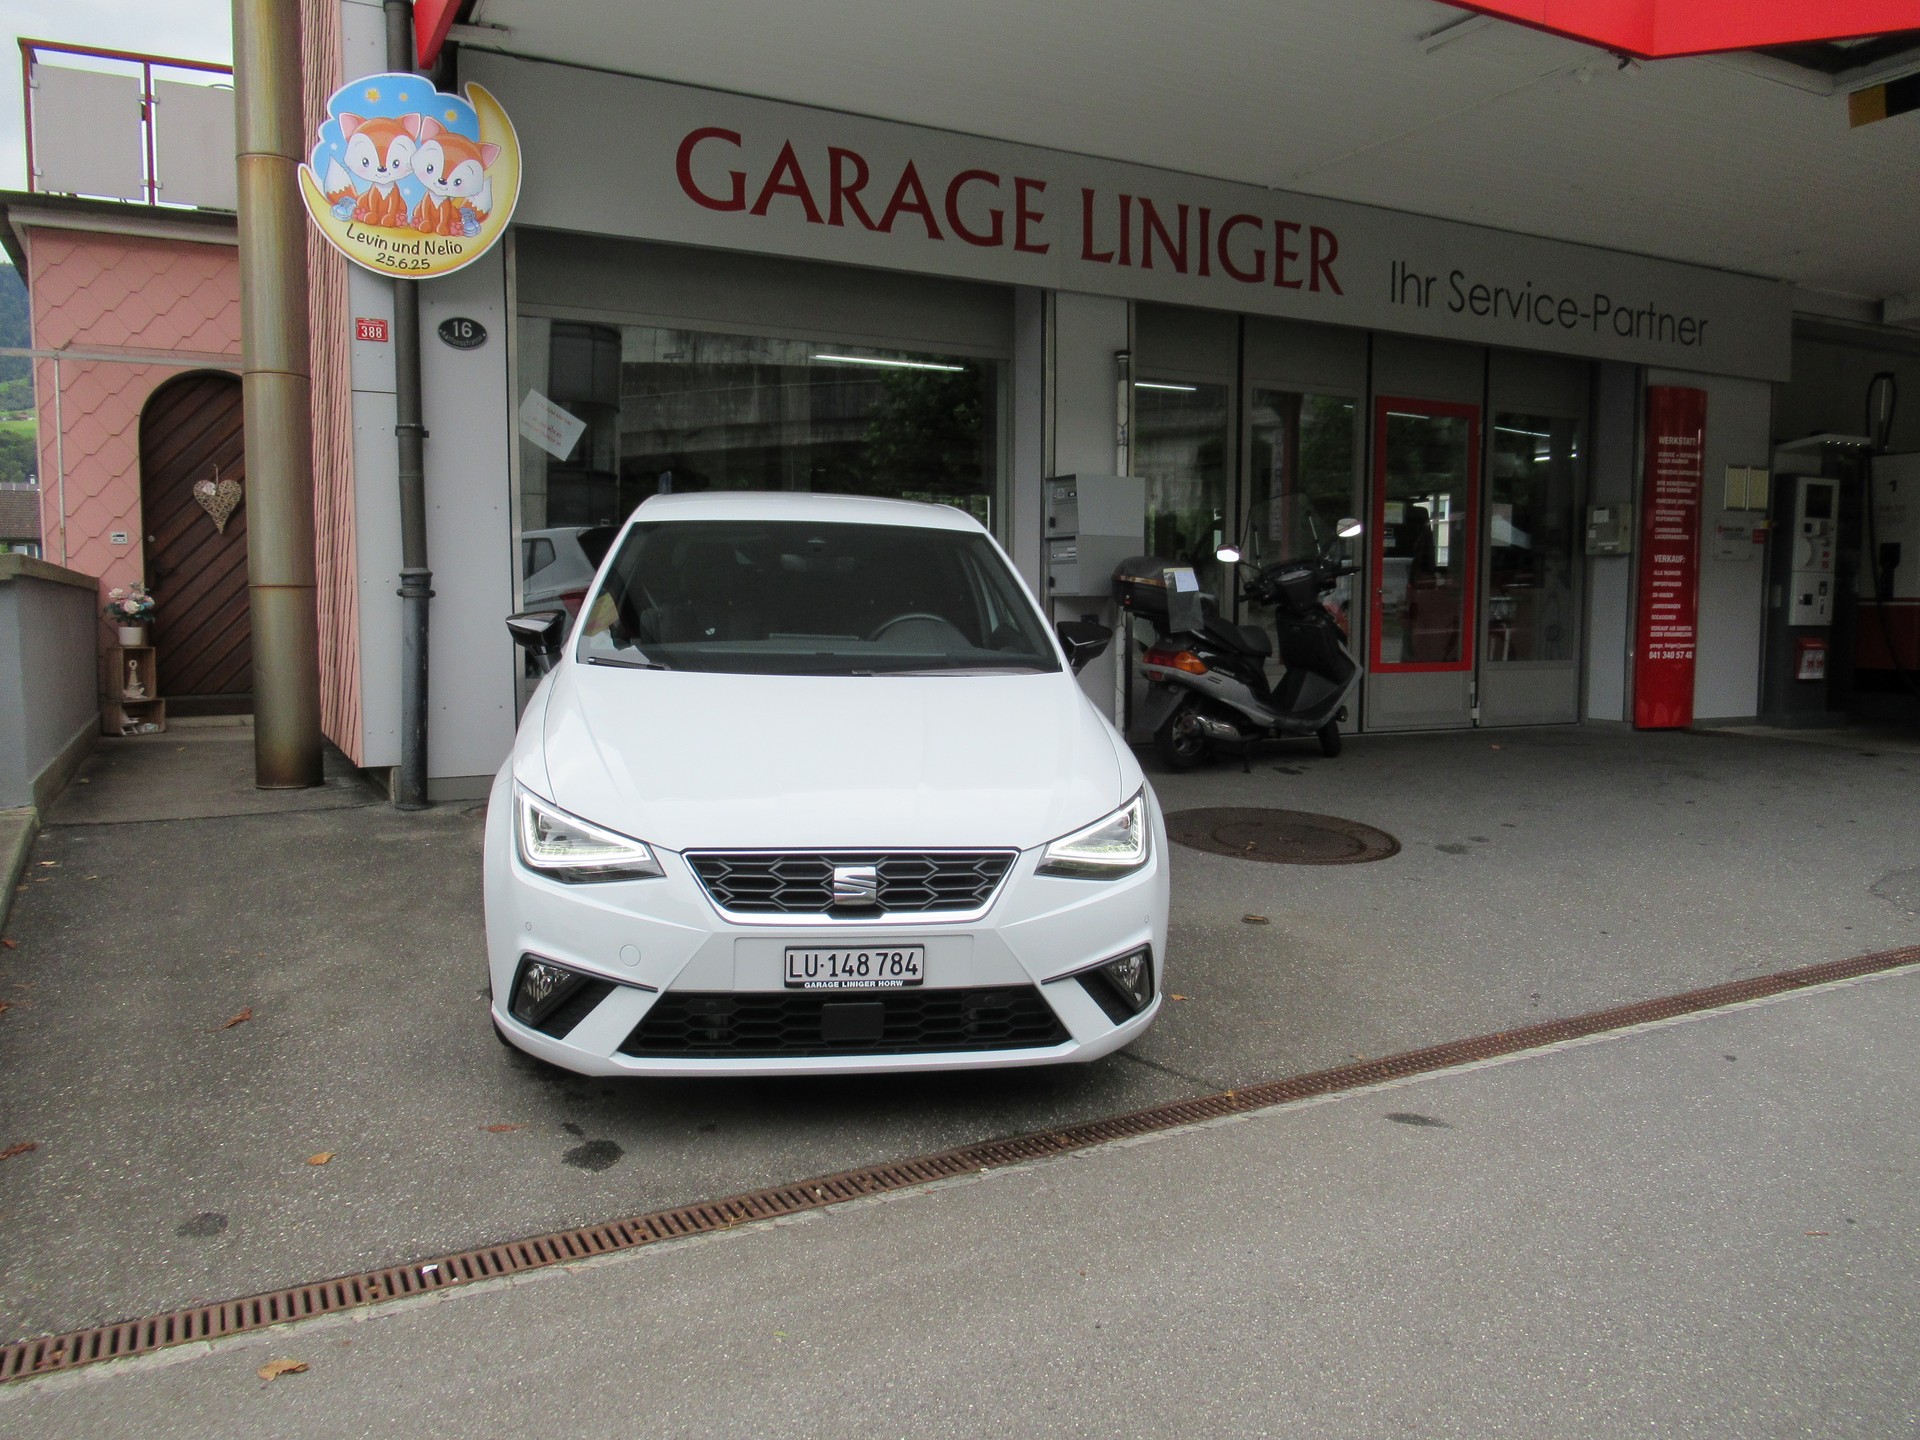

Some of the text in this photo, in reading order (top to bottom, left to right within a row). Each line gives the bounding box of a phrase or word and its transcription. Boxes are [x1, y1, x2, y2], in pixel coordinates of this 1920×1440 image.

[676, 126, 1344, 296] GARAGE LINIGER
[346, 223, 462, 255] Levin und Nelio
[375, 252, 430, 270] 25.6.25
[1391, 260, 1708, 346] Ihr Service-Partner
[361, 325, 382, 339] 388
[453, 320, 473, 338] 16
[1649, 651, 1661, 659] 041
[1662, 651, 1675, 659] 340
[1675, 651, 1685, 659] 57
[841, 980, 876, 988] LINIGER
